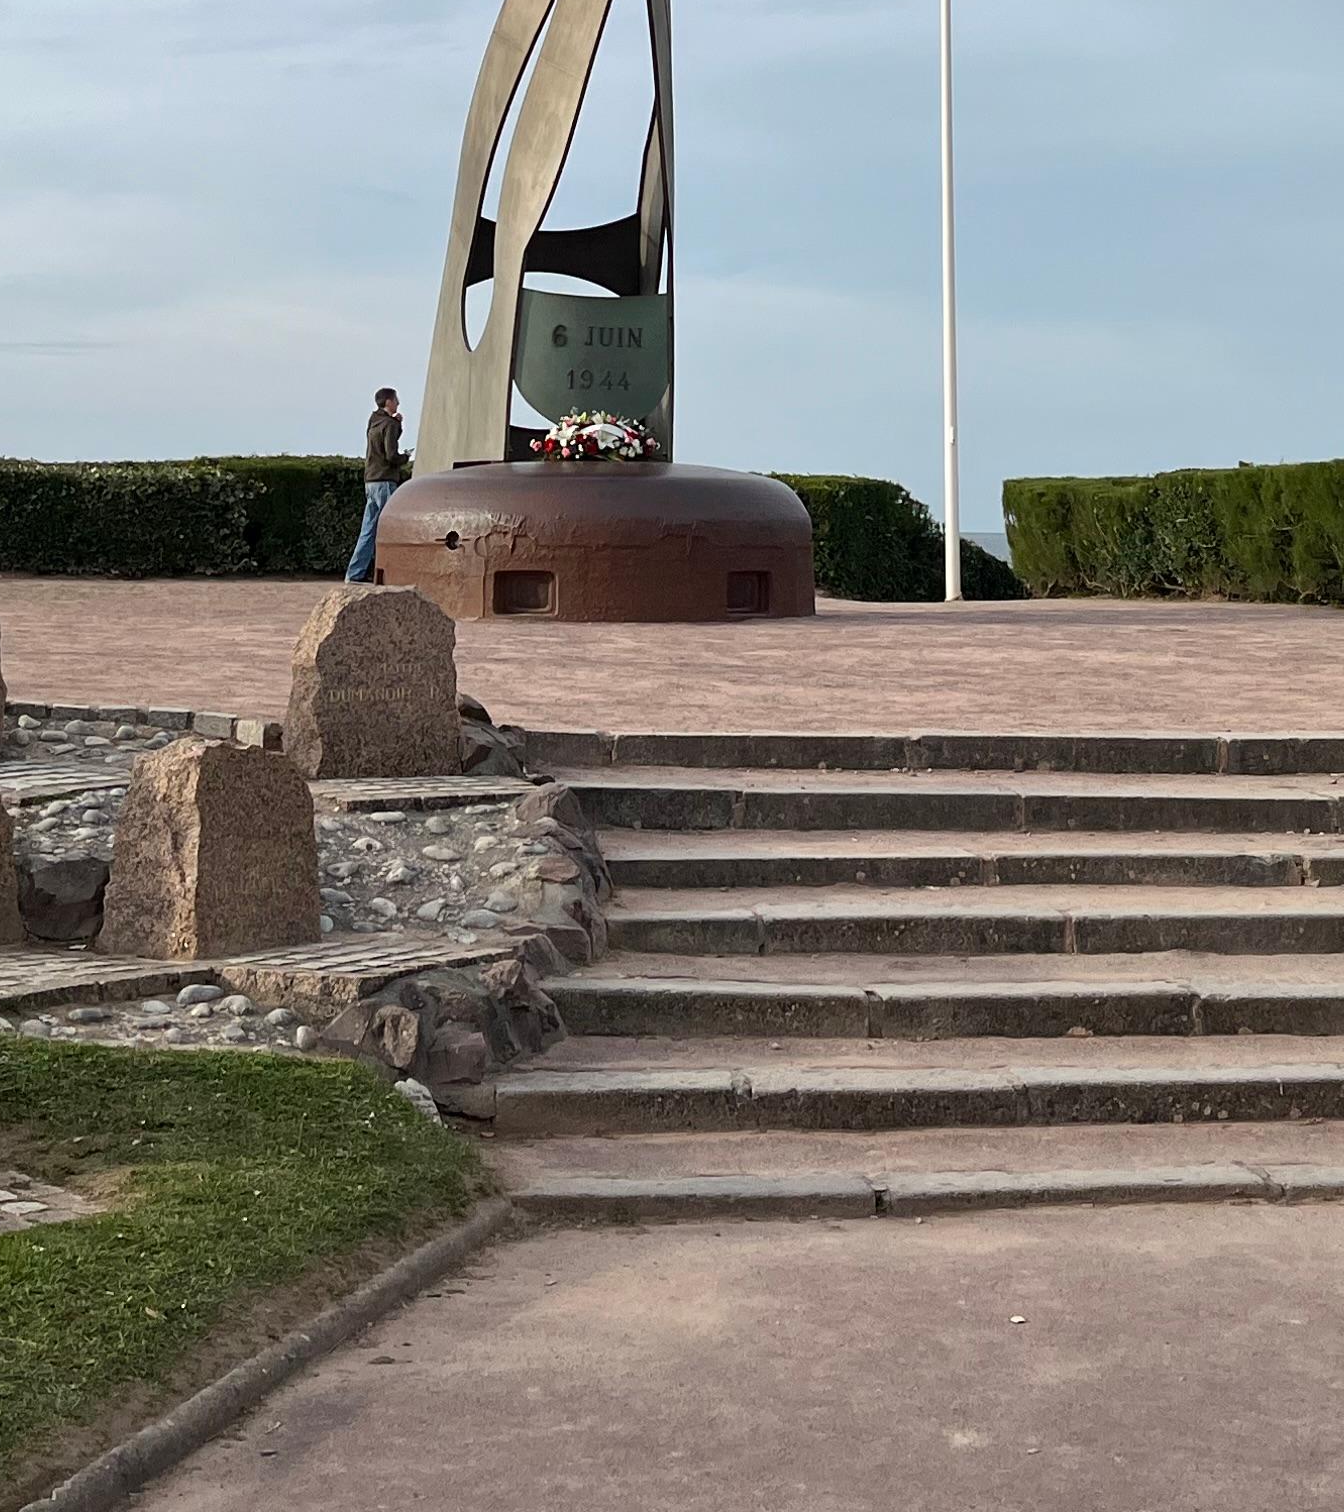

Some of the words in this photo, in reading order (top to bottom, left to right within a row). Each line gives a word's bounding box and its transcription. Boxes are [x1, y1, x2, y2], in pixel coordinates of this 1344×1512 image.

[551, 324, 568, 347] 6
[584, 326, 643, 348] JUIN
[566, 369, 631, 391] 1944
